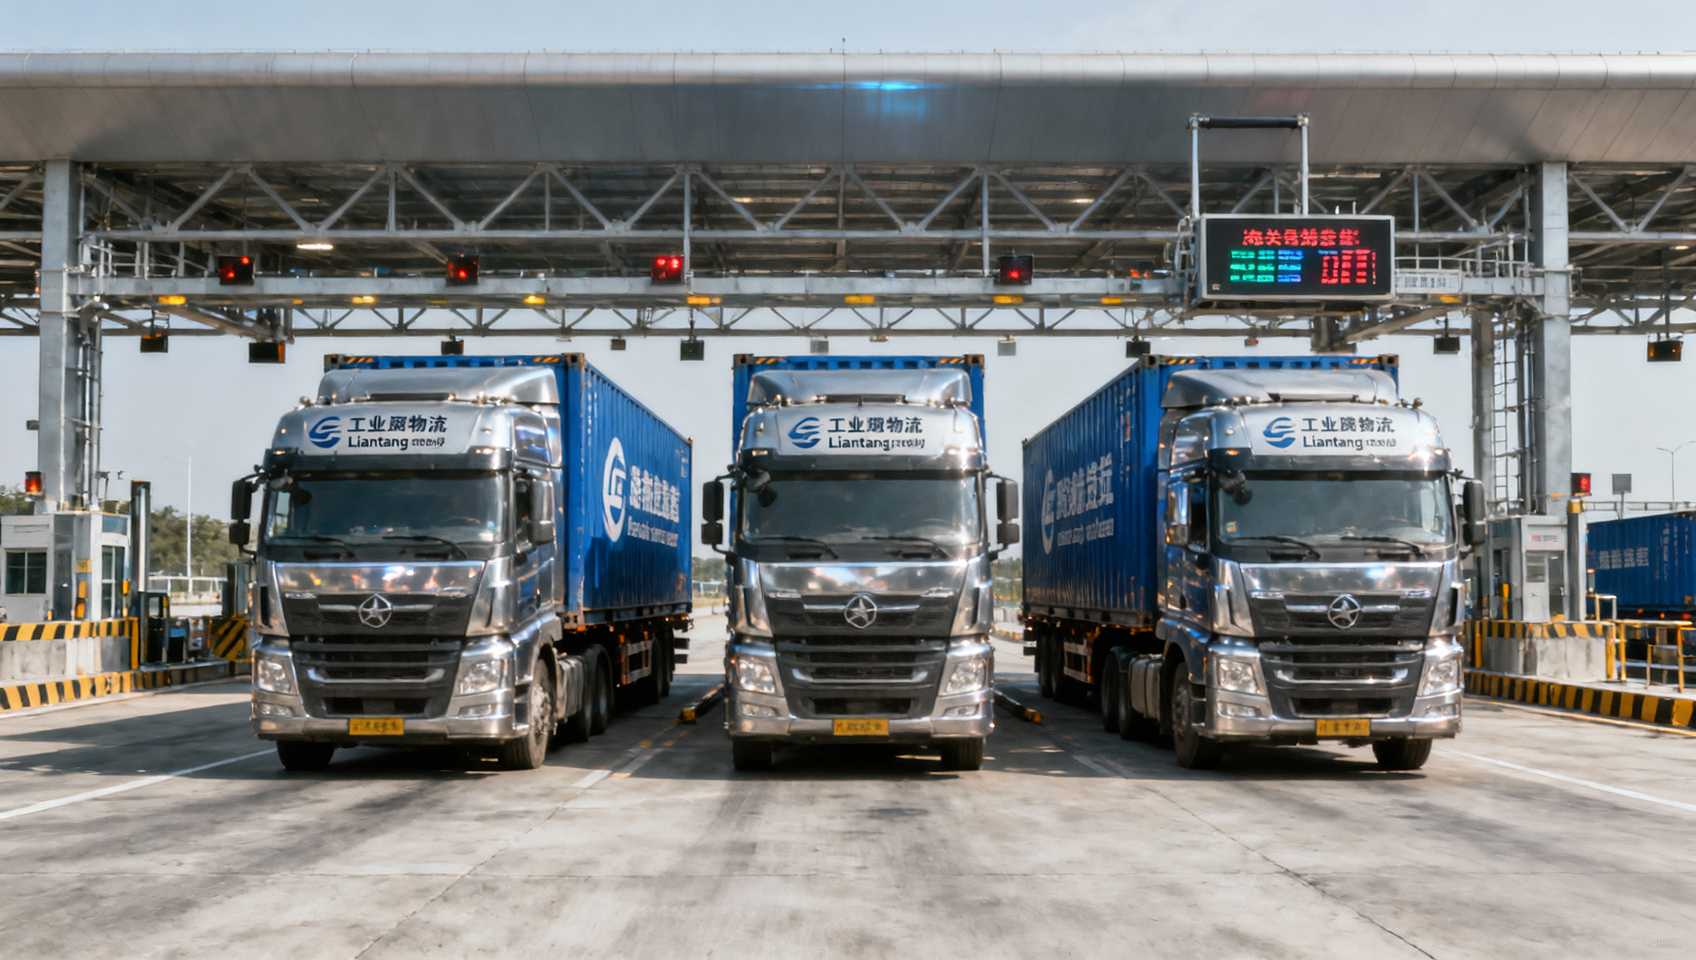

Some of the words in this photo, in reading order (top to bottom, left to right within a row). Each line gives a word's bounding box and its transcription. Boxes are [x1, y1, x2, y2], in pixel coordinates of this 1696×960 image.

[348, 436, 409, 450] Liantang
[828, 436, 890, 451] Liantang
[1303, 435, 1363, 451] Liantang
